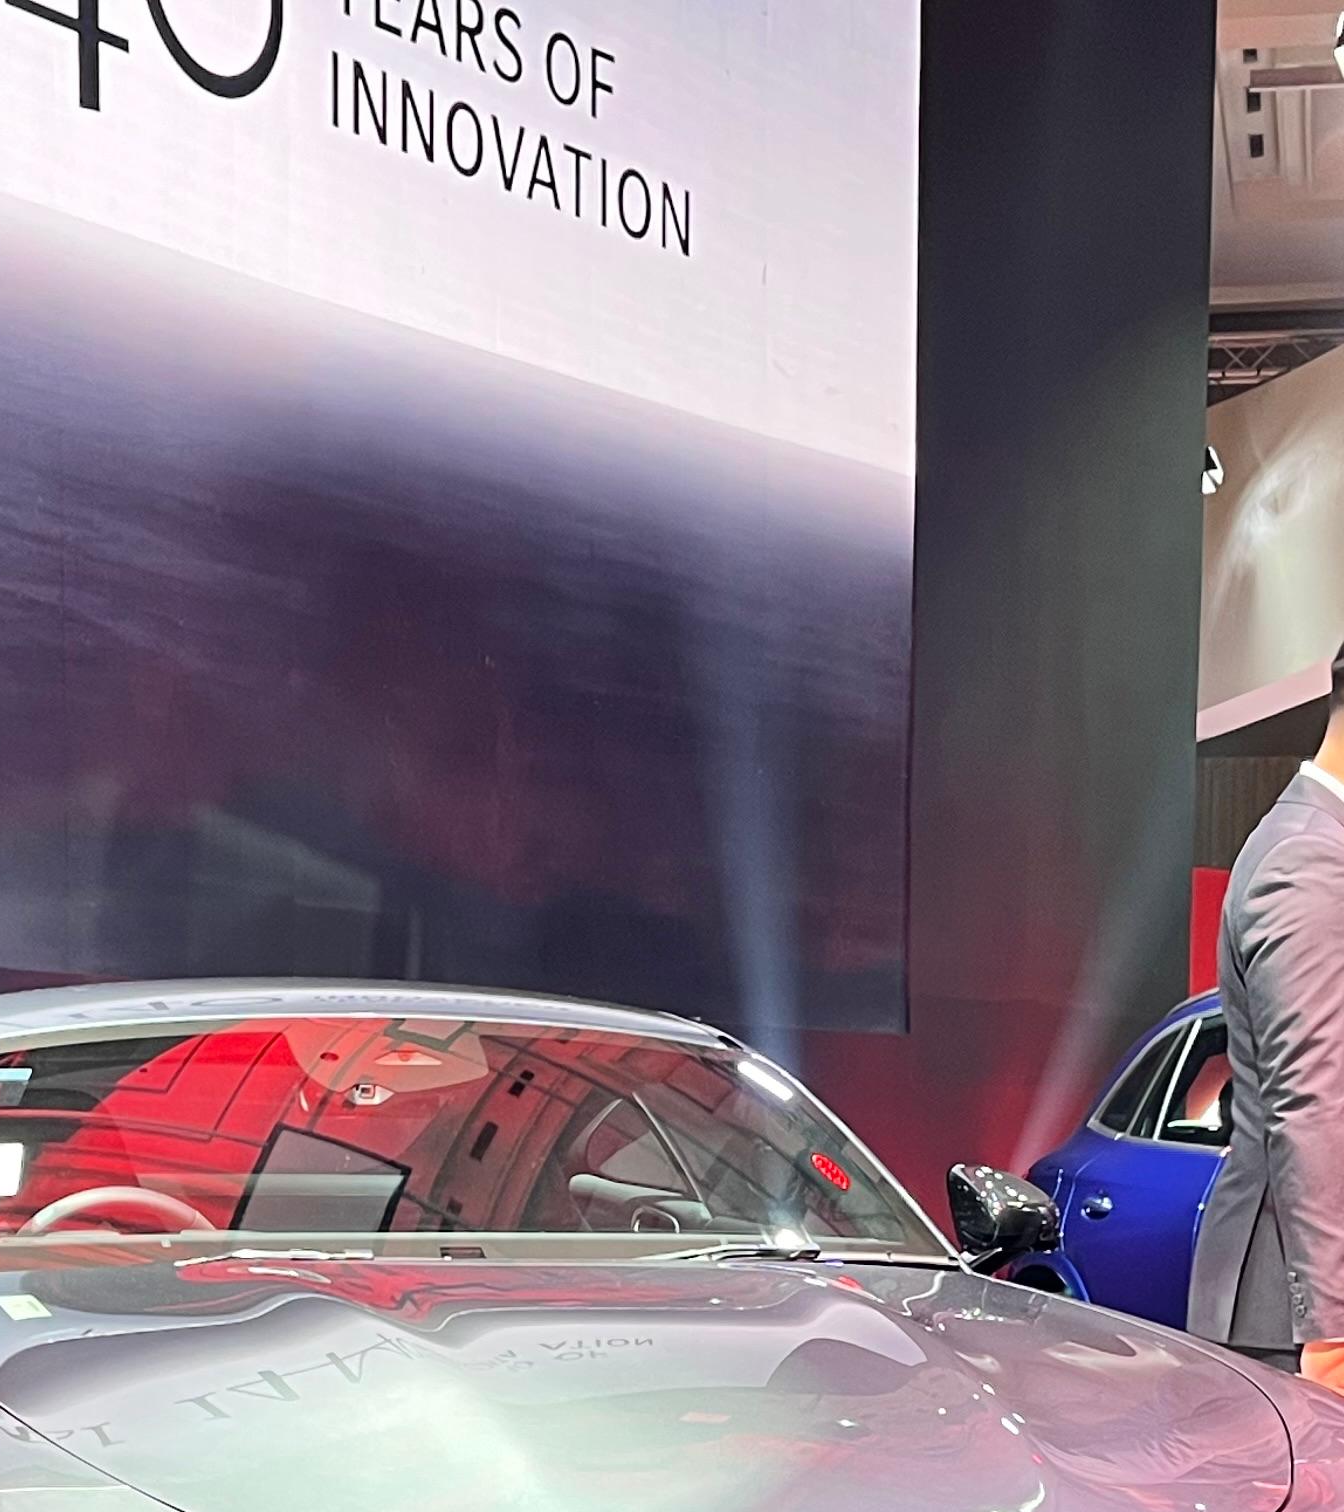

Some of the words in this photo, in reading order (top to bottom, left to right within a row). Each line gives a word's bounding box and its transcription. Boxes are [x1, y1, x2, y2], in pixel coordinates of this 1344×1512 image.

[343, 0, 523, 83] ARS
[545, 32, 616, 119] OF
[332, 50, 690, 257] INNOVATION
